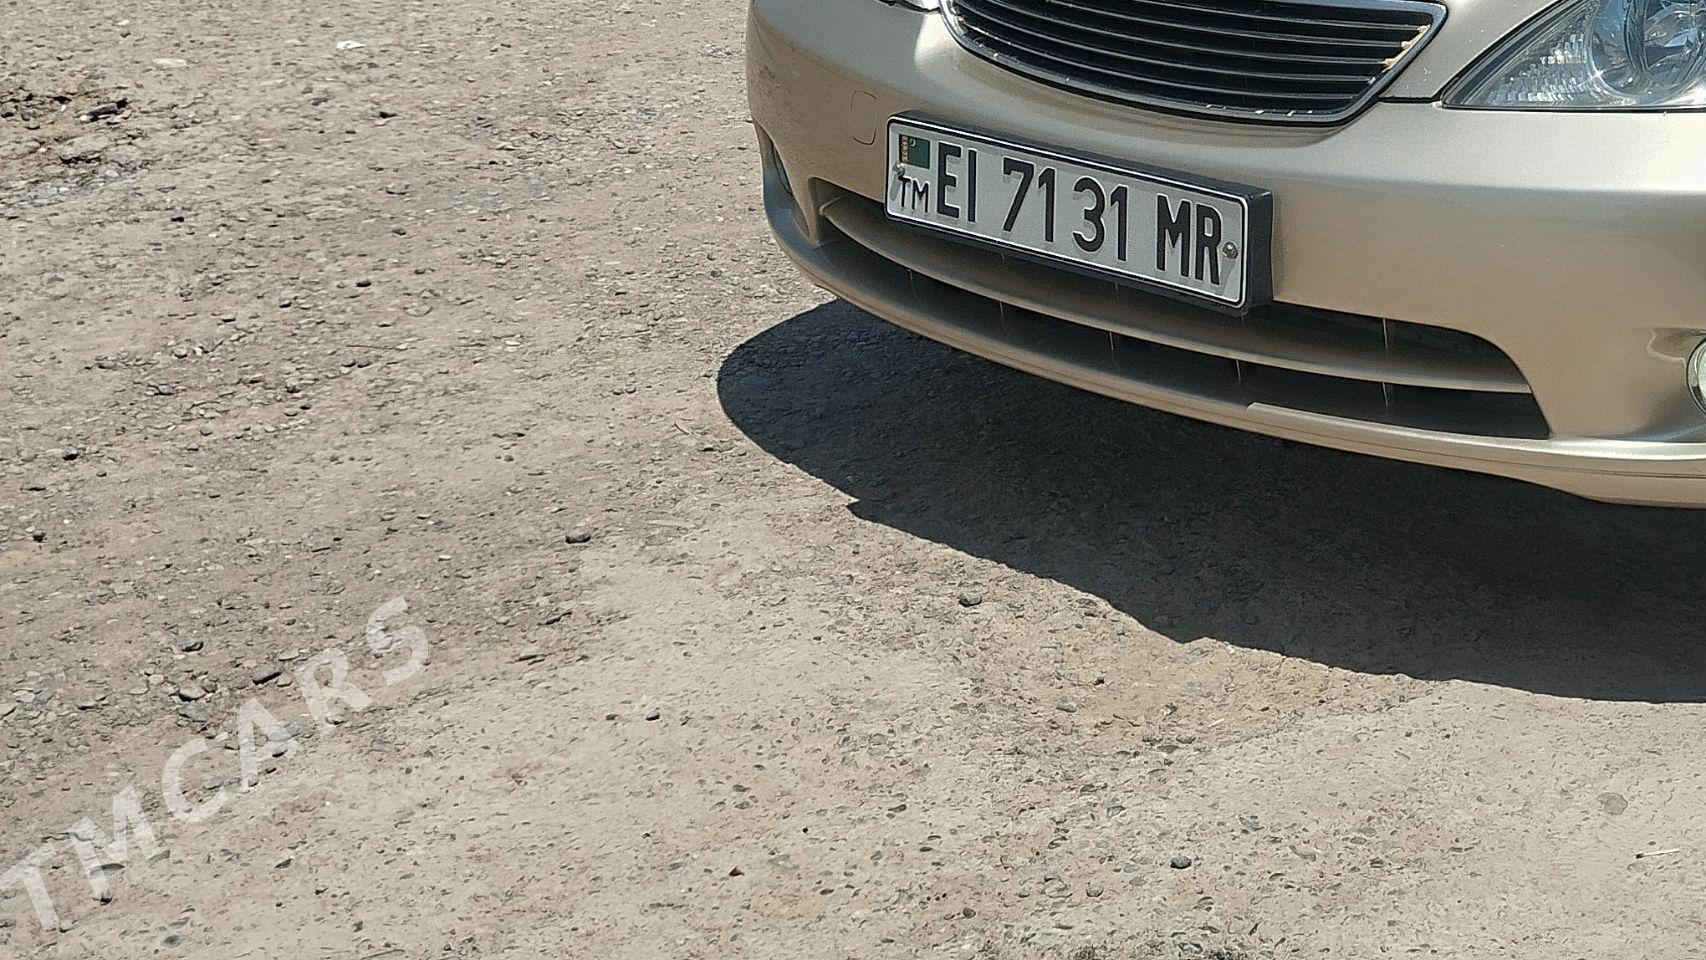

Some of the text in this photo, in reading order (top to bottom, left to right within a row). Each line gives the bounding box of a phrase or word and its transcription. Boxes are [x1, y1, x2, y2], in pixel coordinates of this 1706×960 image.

[897, 175, 930, 214] TM
[936, 140, 1223, 286] EI 71 31 MR
